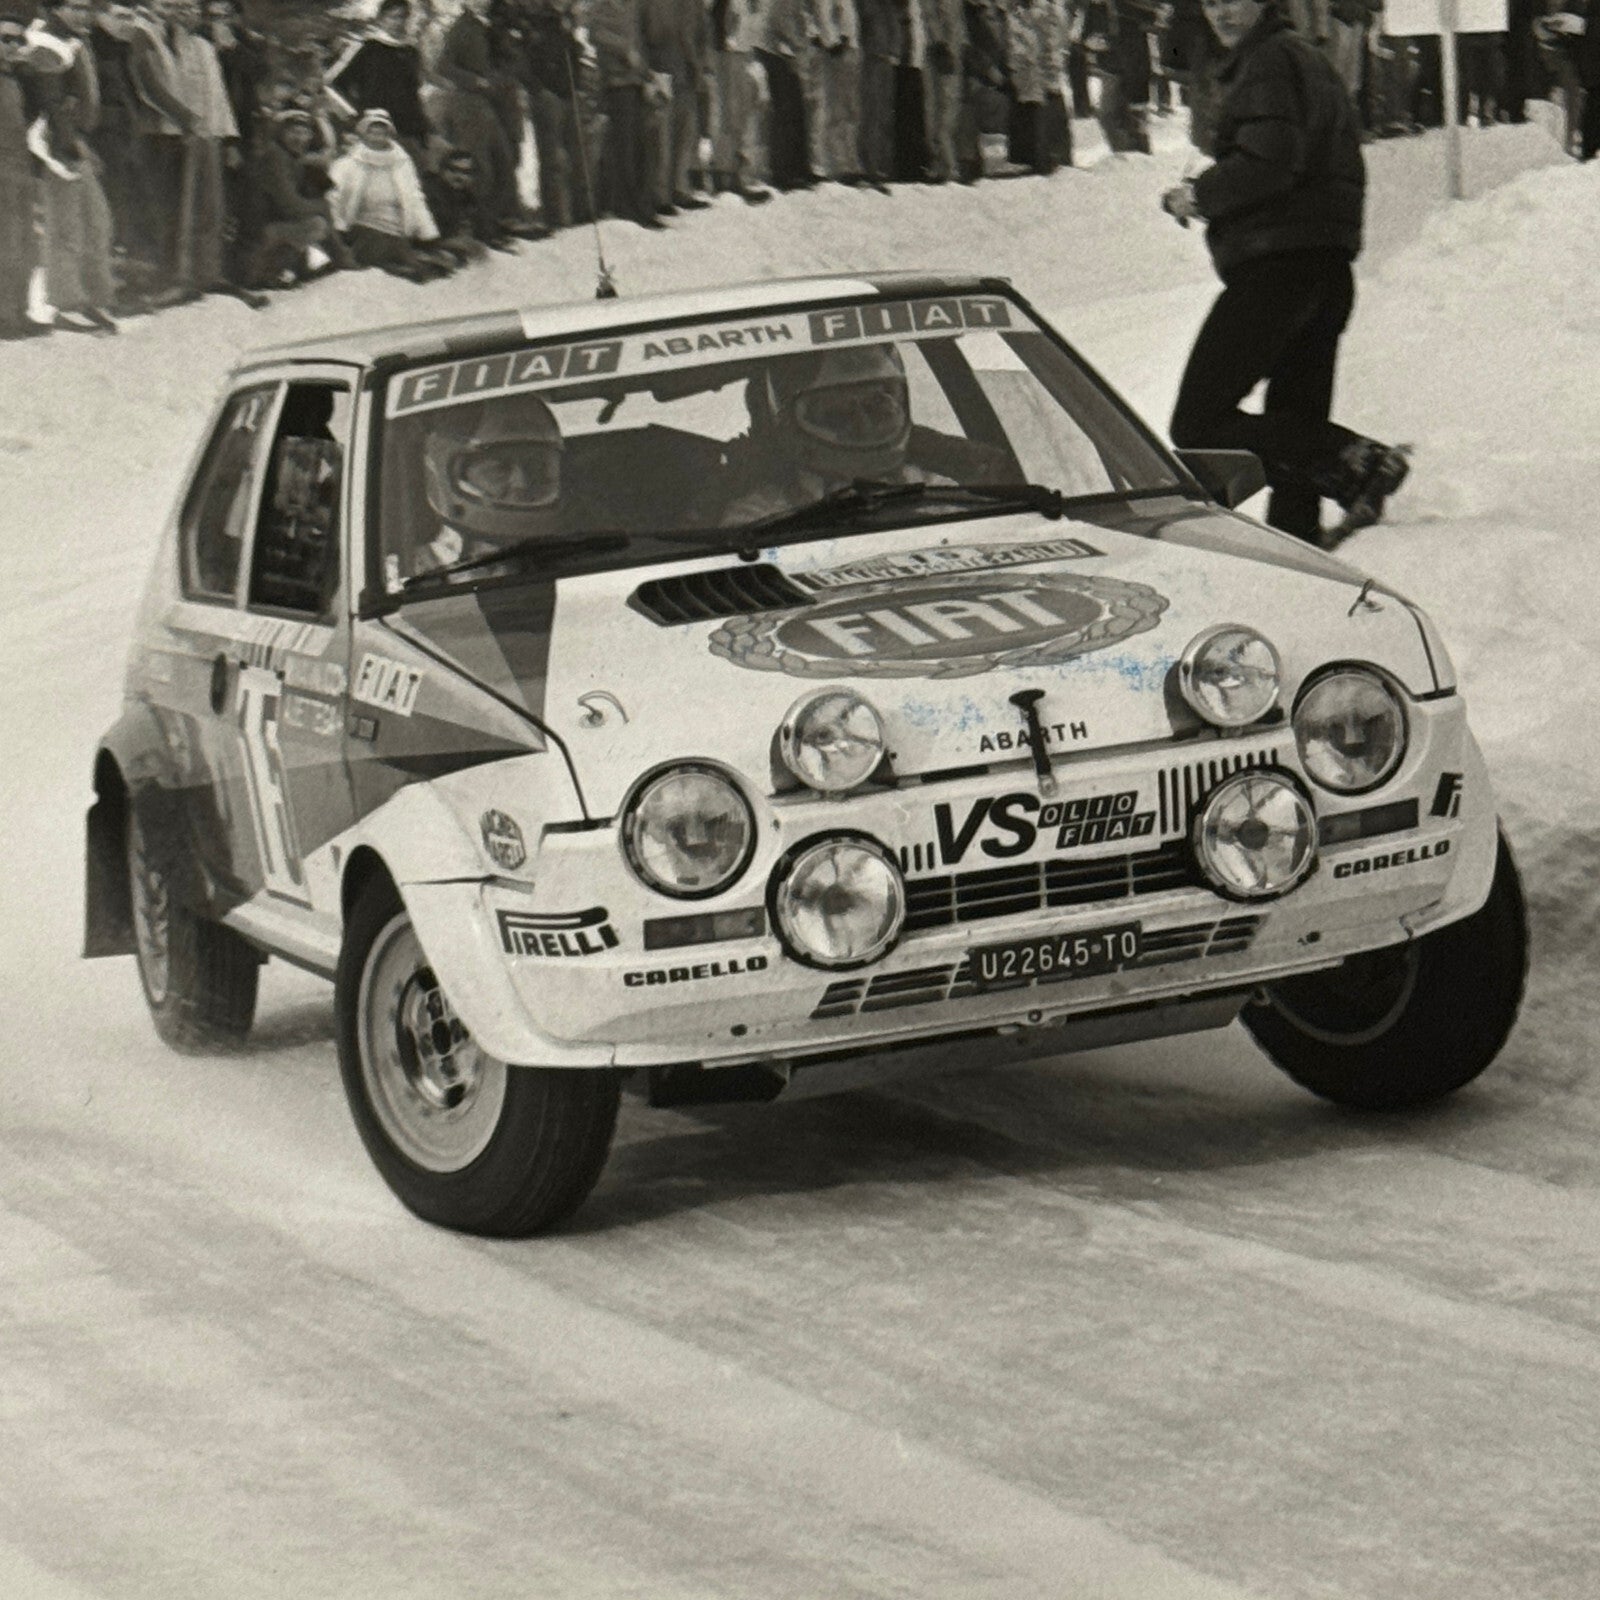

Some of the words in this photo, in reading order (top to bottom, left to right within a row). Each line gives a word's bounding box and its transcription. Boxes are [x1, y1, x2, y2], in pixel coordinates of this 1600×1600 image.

[412, 347, 614, 402] FIAT
[642, 322, 794, 361] ABARTH
[820, 302, 998, 338] FIAT
[808, 590, 1066, 656] FIAT
[357, 656, 418, 709] FIAT
[933, 792, 1041, 866] VS
[1042, 794, 1136, 826] OLIO
[1059, 813, 1153, 847] FIAT
[1333, 839, 1450, 879] CARELLO
[497, 906, 620, 958] PIRELLI
[623, 955, 768, 987] CARELLO
